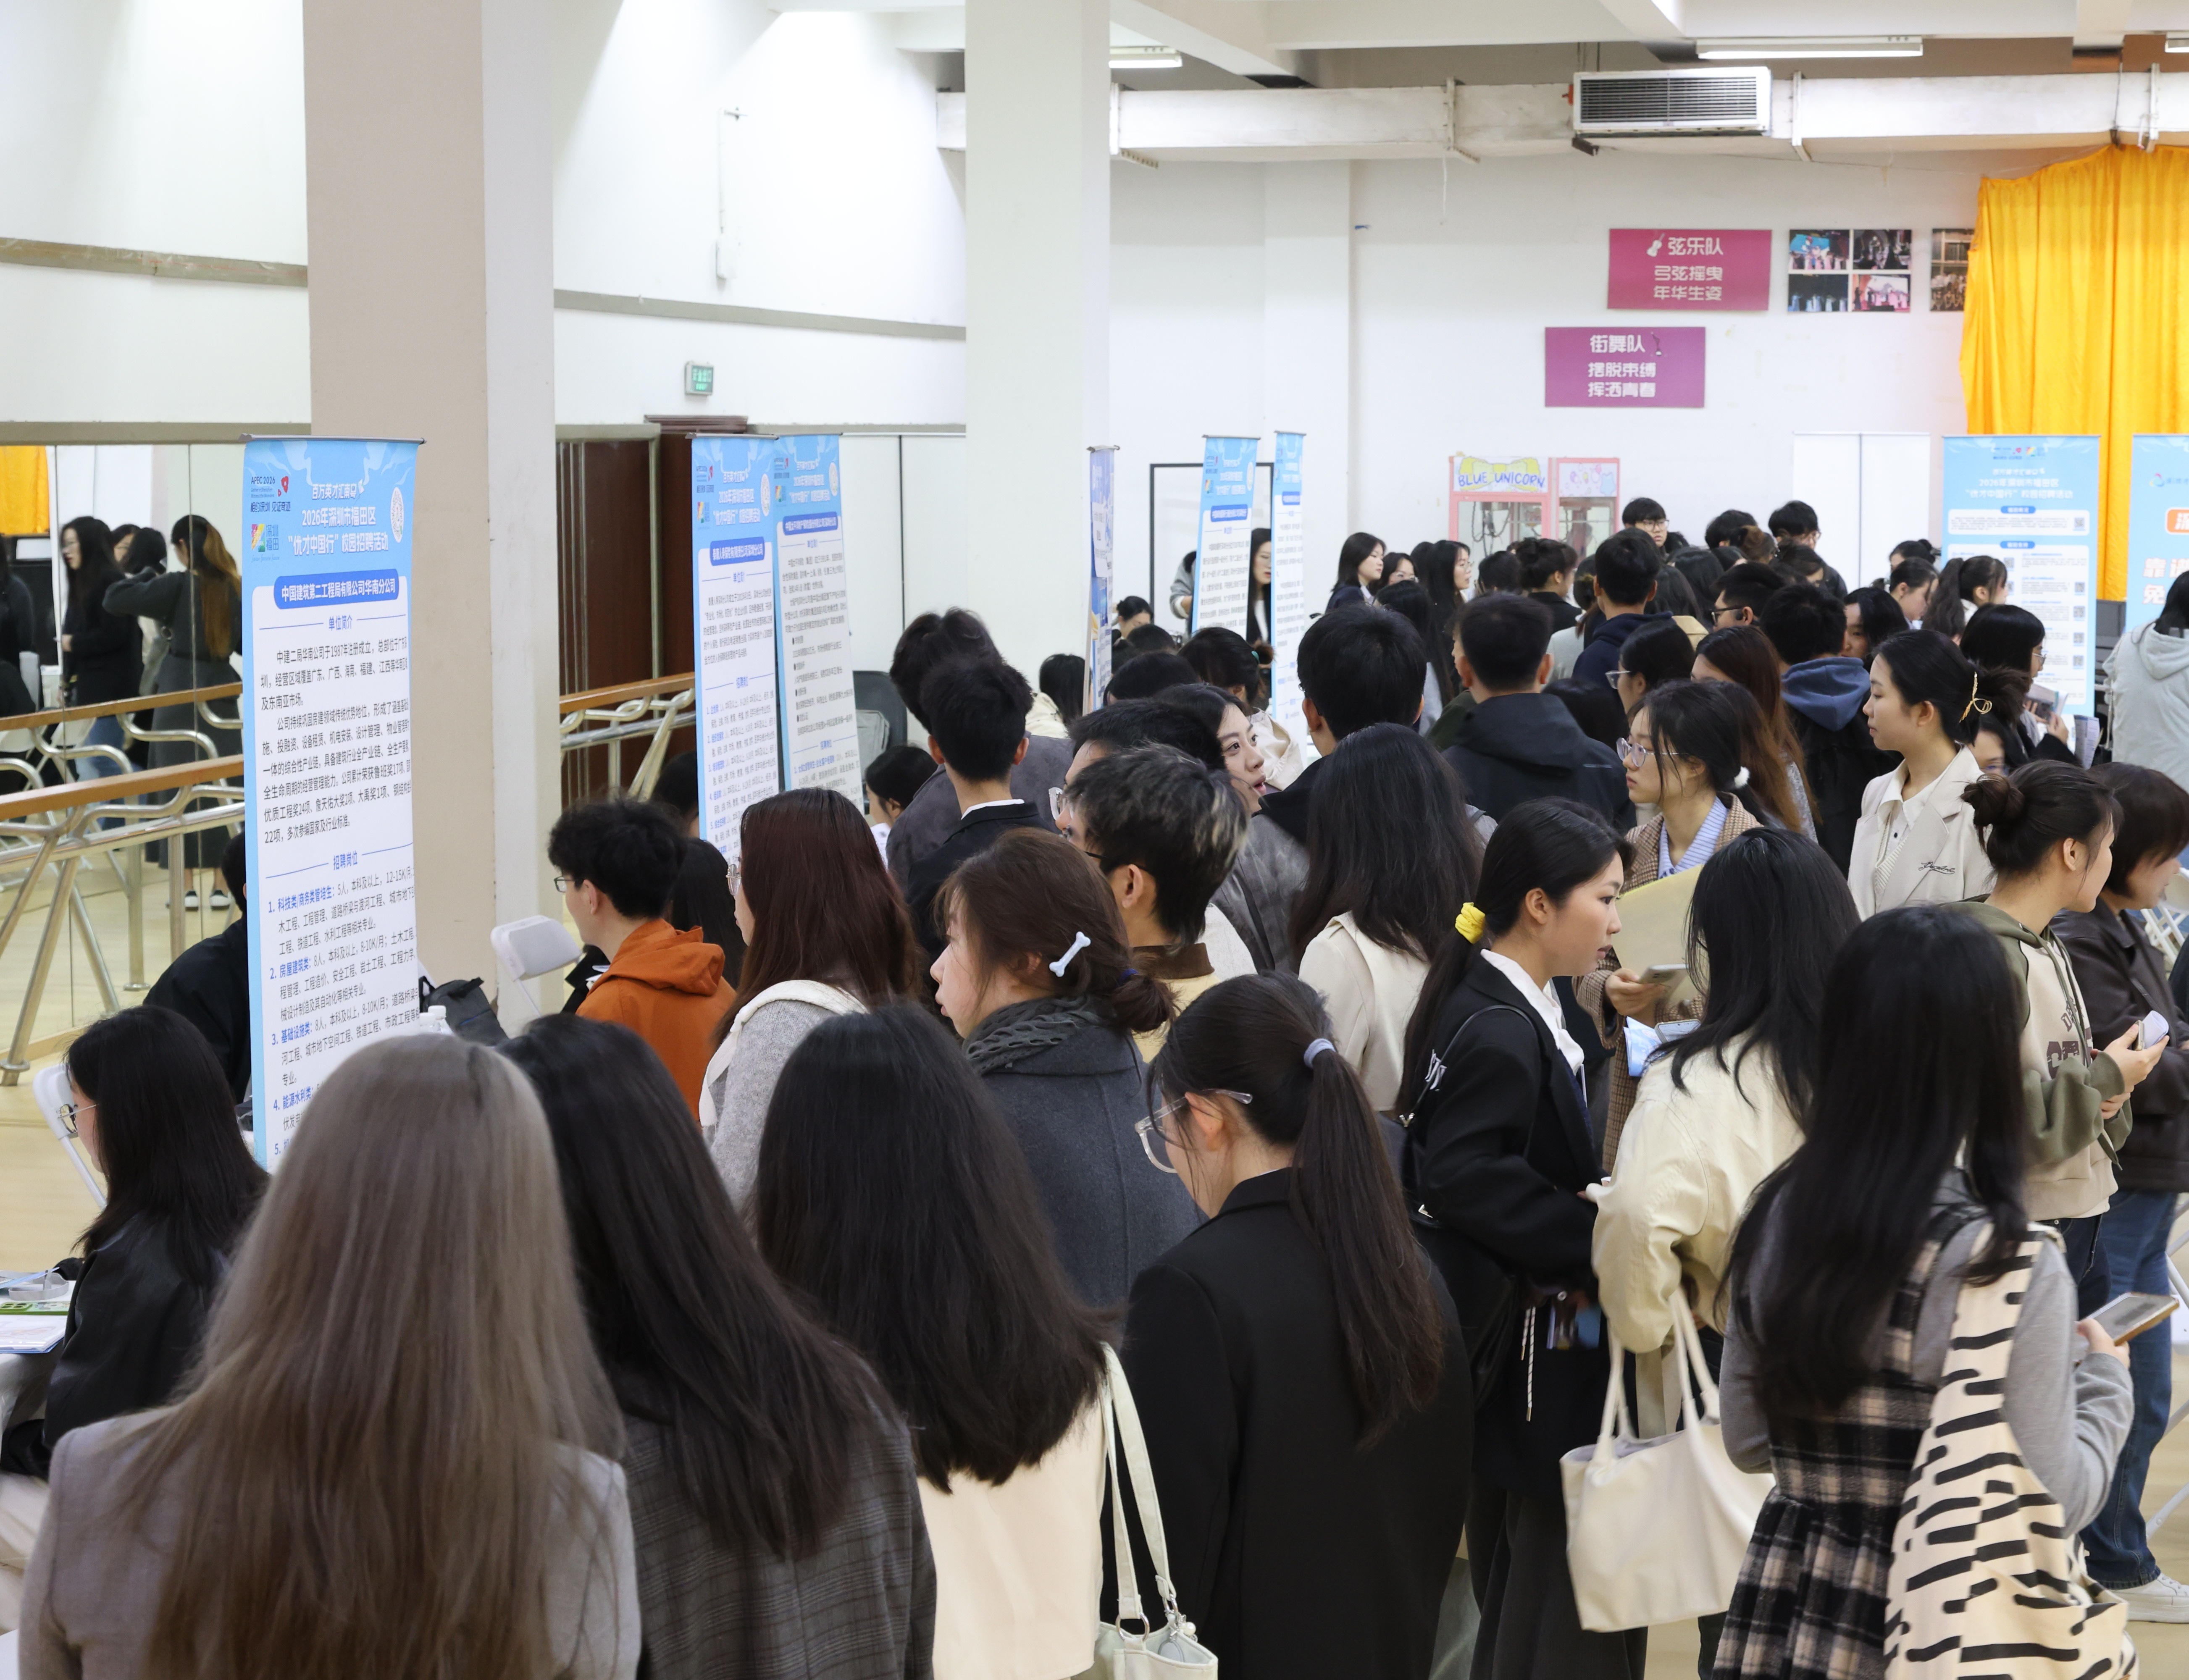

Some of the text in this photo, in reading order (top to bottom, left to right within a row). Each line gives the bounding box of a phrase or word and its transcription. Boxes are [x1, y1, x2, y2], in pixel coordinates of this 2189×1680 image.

[1668, 237, 1724, 256] 弦乐队
[1654, 265, 1723, 281] 弓弦摇曳
[1653, 286, 1722, 301] 年华生姿
[1590, 334, 1645, 354] 街舞队
[1588, 362, 1656, 378] 摆脱束缚
[1588, 381, 1656, 398] 挥洒青春
[1458, 471, 1545, 488] BLUE UNICORN
[312, 483, 357, 500] 百万英才汇南粤
[272, 501, 291, 512] 见证奇迹
[302, 507, 376, 527] 2026年深圳市福田区
[266, 538, 279, 551] 福田
[288, 532, 389, 556] “优才中国行” 校园招聘活动
[281, 578, 396, 602] 中国建筑第二工程局有限公司华南分公司
[328, 614, 353, 631] 单位简介
[261, 693, 304, 711] 及东南亚市场。
[265, 814, 350, 844] 22项，多次参编国家及行业标准。
[333, 850, 358, 870] 招聘岗位
[279, 916, 376, 956] 工程、铁道工程、水利工程等相关专业。
[281, 982, 366, 1023] 械设计制造及其自动化等相关专业。
[282, 1071, 297, 1087] 专业。
[283, 1081, 323, 1110] 能源水利类：5
[283, 1110, 305, 1131] 伏发电
